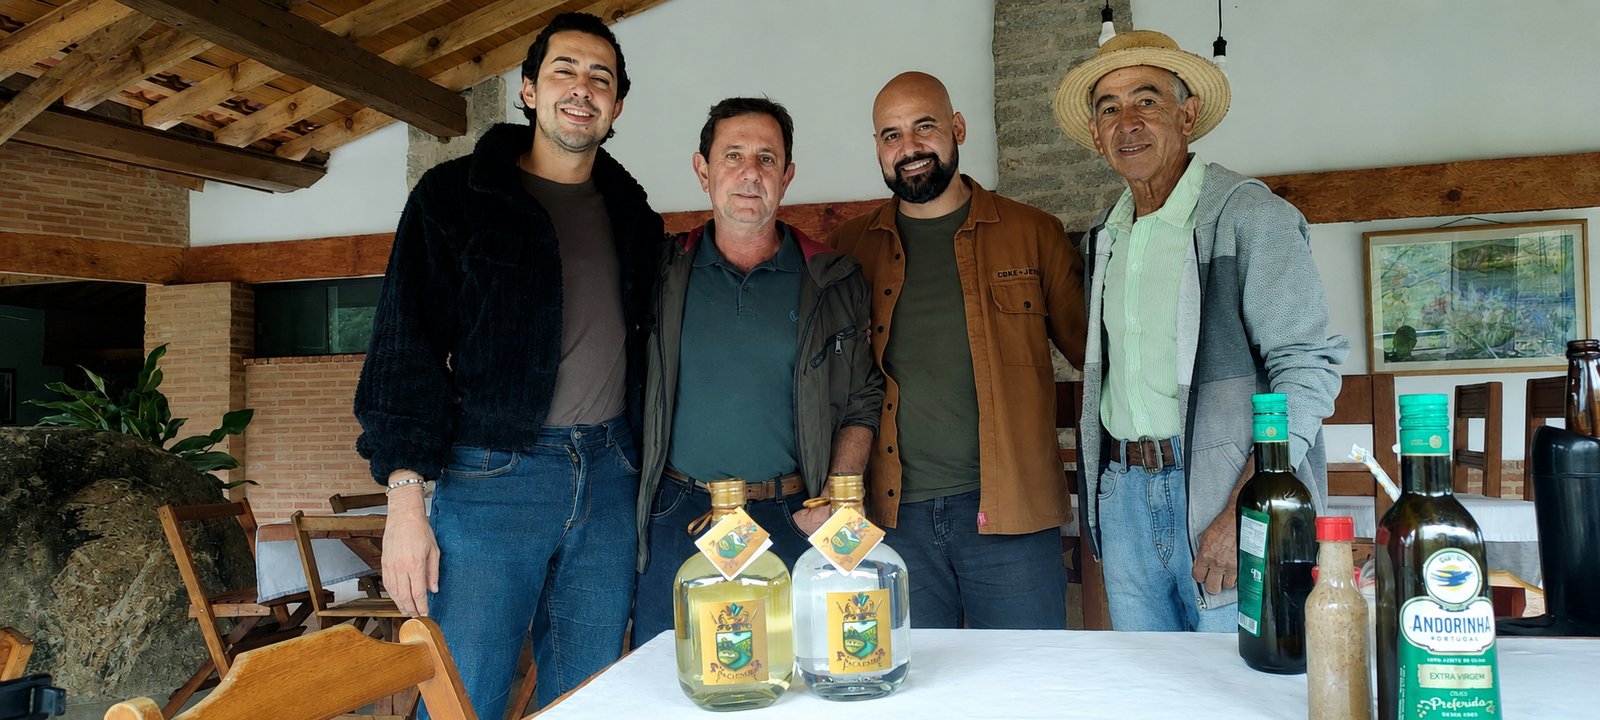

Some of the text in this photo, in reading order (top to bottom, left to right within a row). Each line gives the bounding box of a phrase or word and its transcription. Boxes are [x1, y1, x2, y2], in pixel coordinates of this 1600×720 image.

[1412, 614, 1492, 634] ANDORINHA
[1429, 672, 1456, 680] EXTRA
[1423, 696, 1491, 711] Preferido
